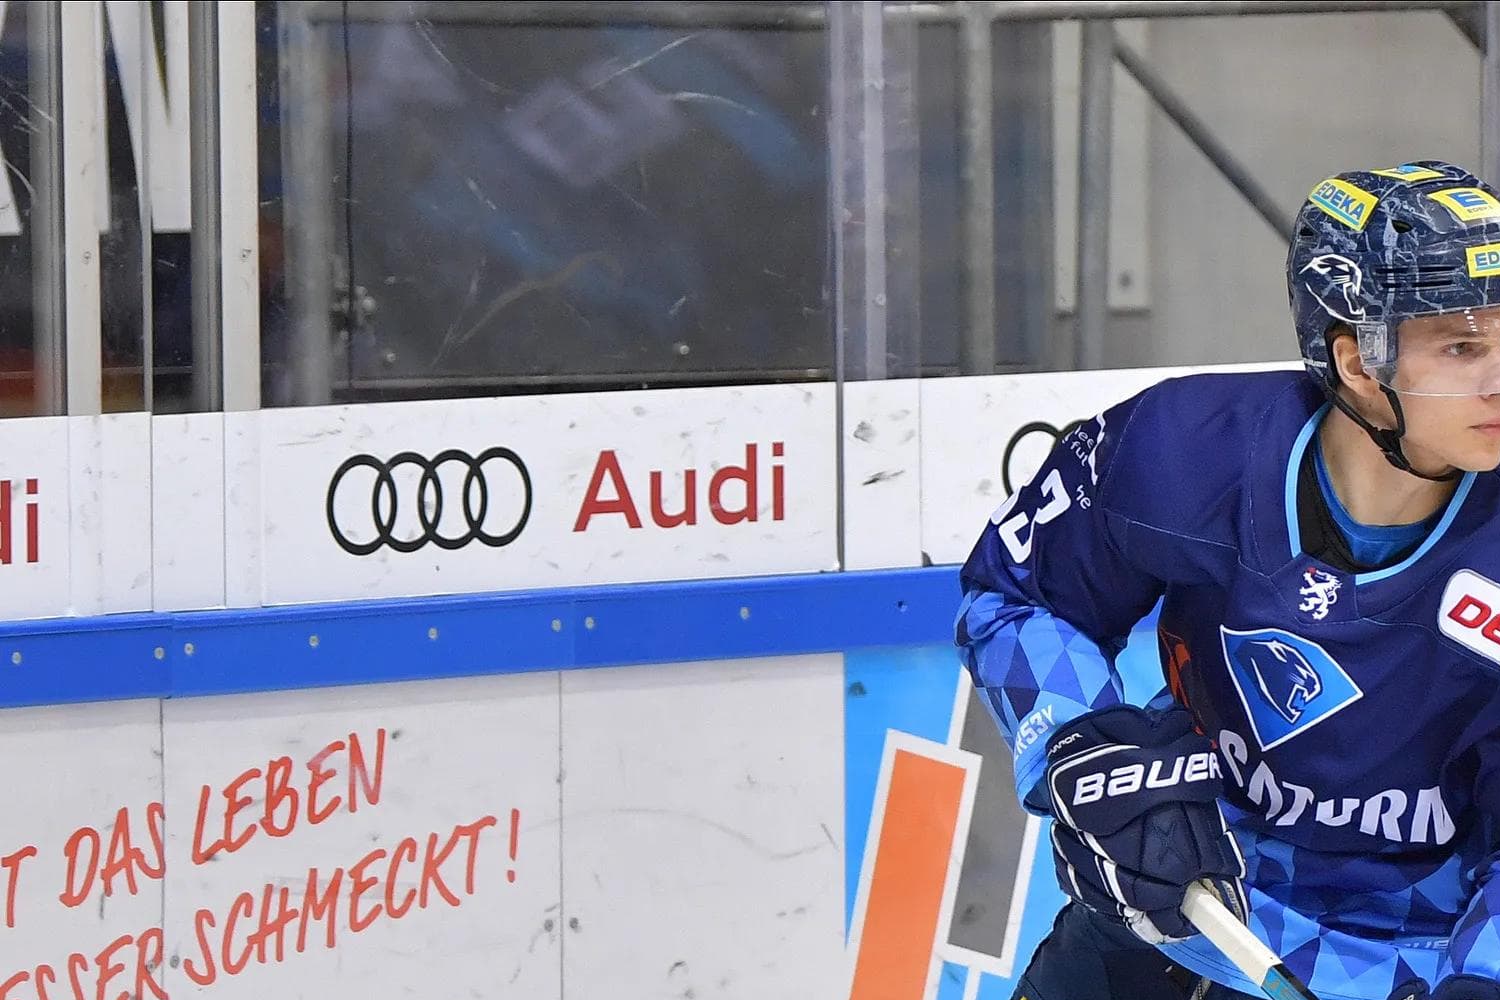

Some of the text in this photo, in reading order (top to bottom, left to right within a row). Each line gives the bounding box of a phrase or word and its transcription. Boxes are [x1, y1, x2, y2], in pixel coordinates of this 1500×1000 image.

[1317, 181, 1365, 220] EDEKA
[573, 442, 785, 533] Audi
[59, 802, 165, 908] DAS
[191, 727, 387, 866] LEBEN
[1072, 752, 1223, 806] BAUER
[178, 808, 521, 986] SCHMECKT!
